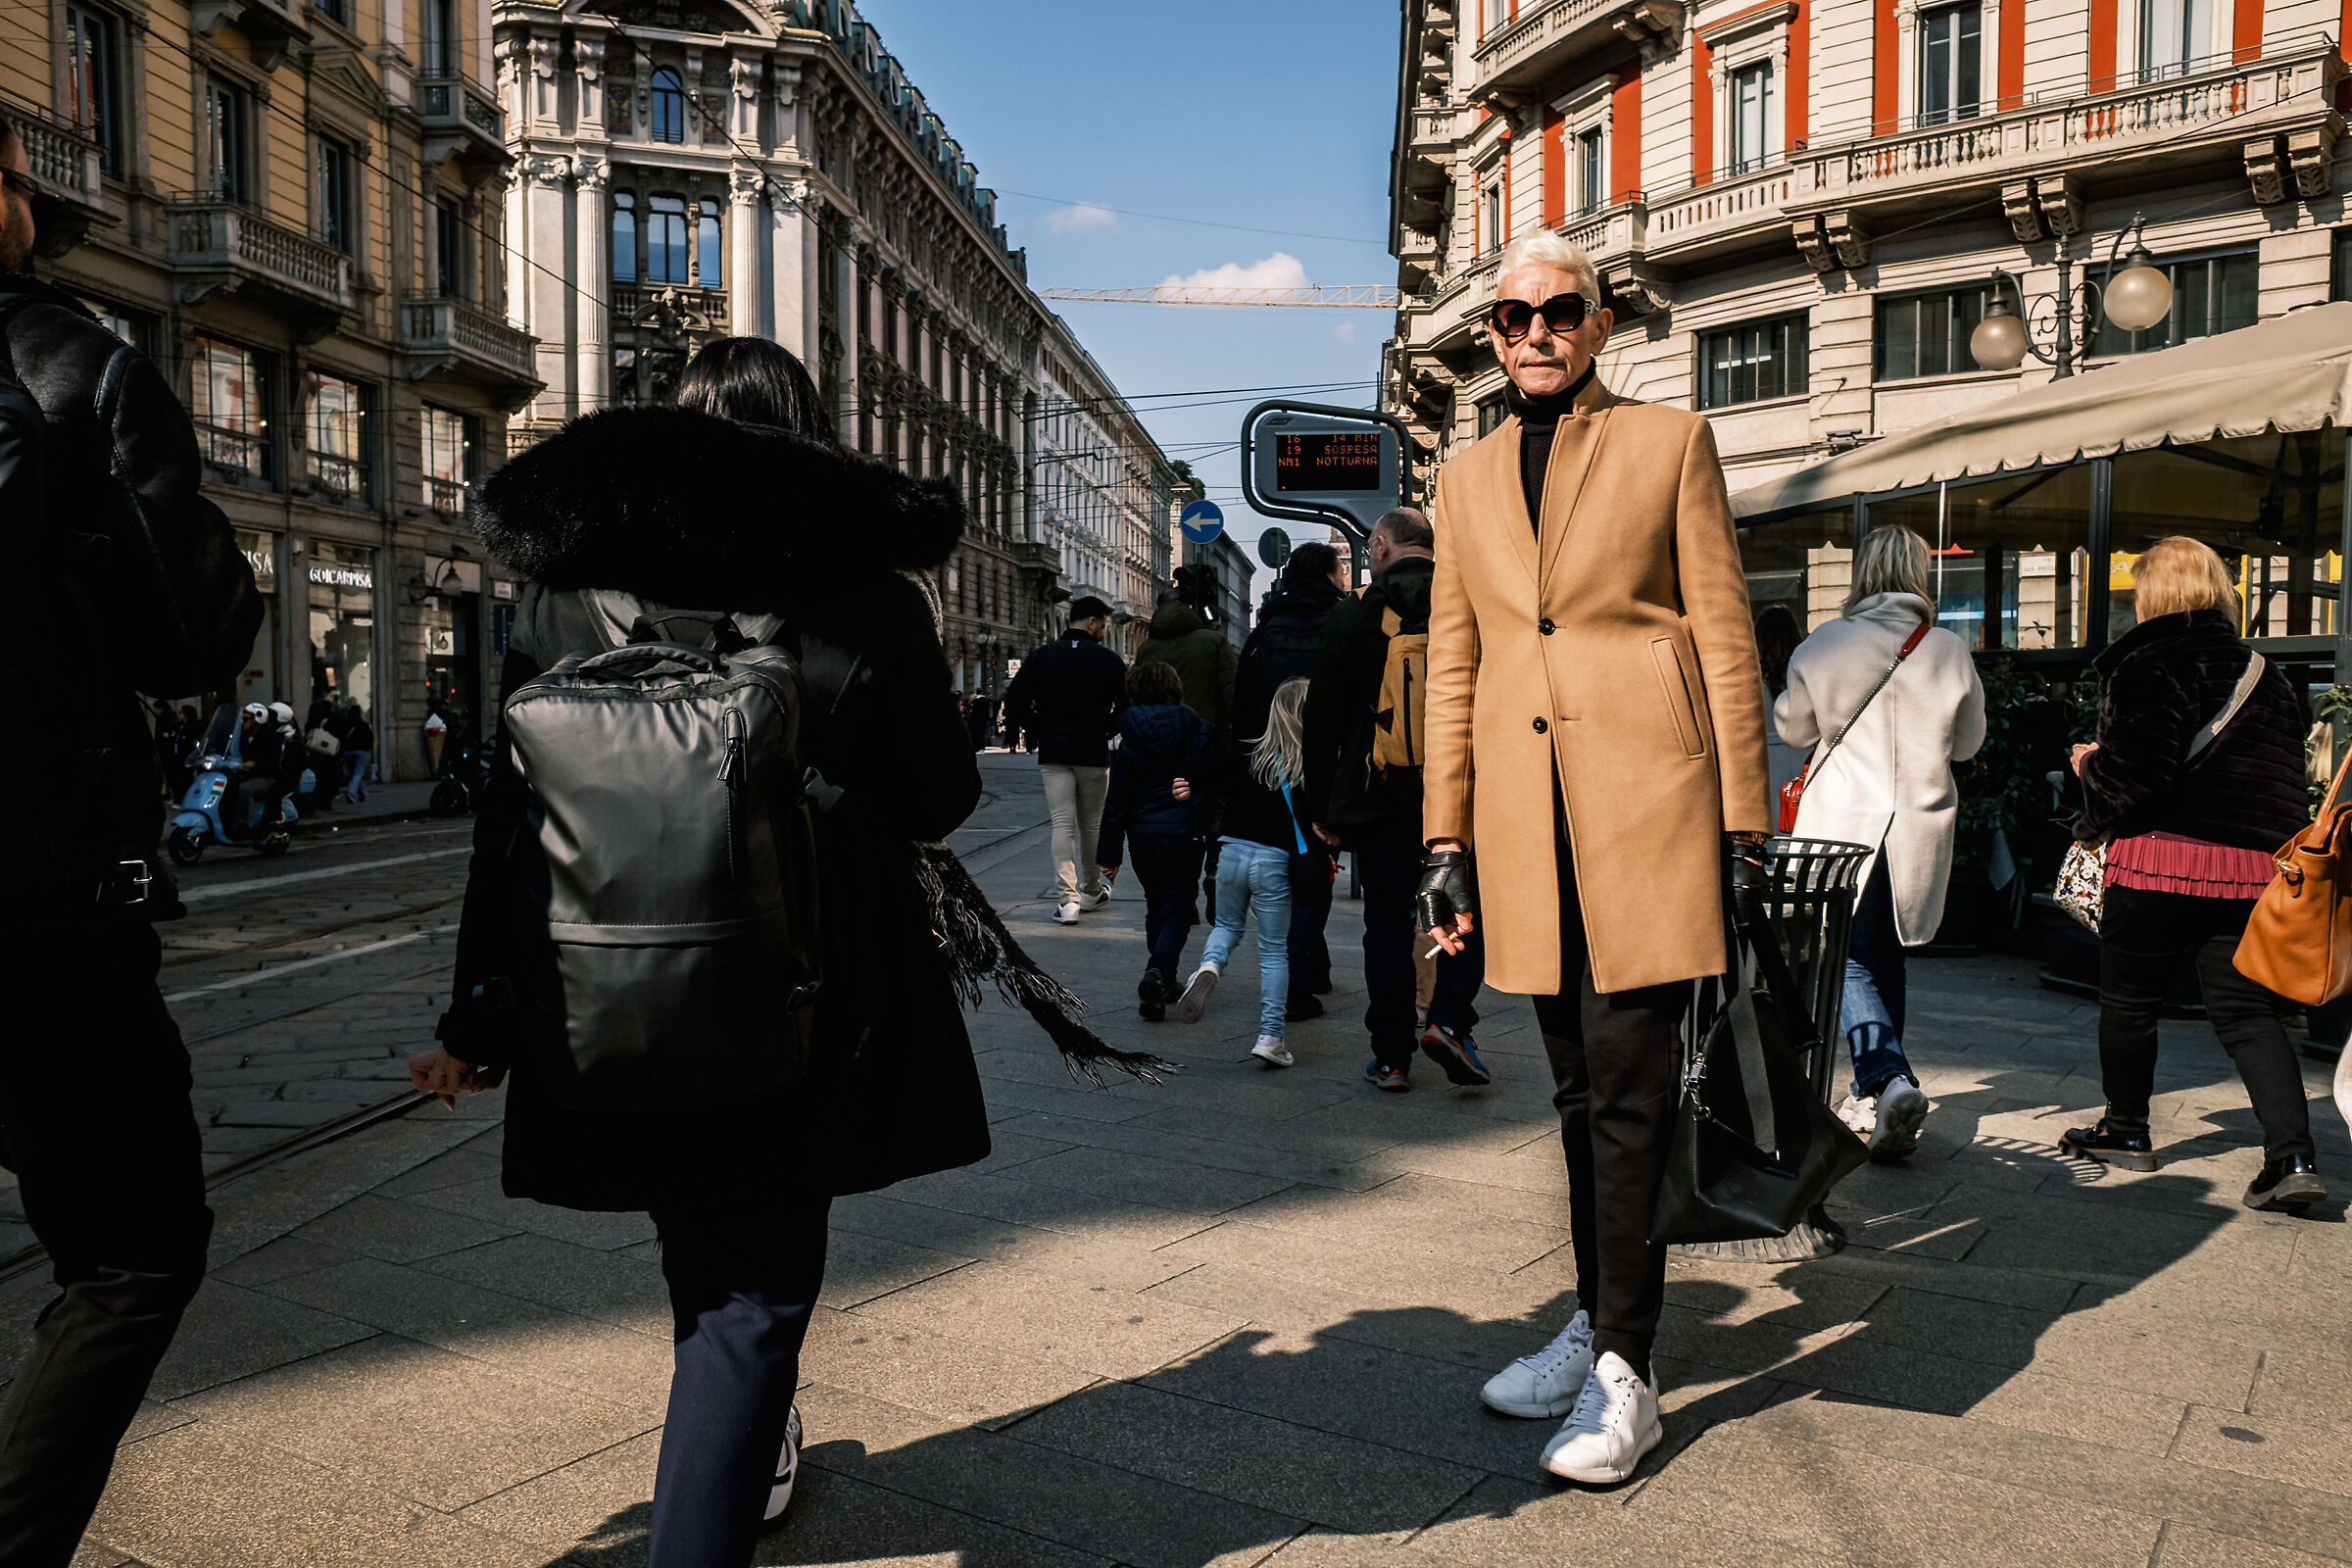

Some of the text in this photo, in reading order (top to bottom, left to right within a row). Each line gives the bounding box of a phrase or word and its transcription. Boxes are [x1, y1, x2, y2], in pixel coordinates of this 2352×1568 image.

[1287, 434, 1301, 443] 16
[1287, 445, 1378, 455] 19 SOSPESA
[1278, 457, 1378, 466] NM1 NOTTURNA
